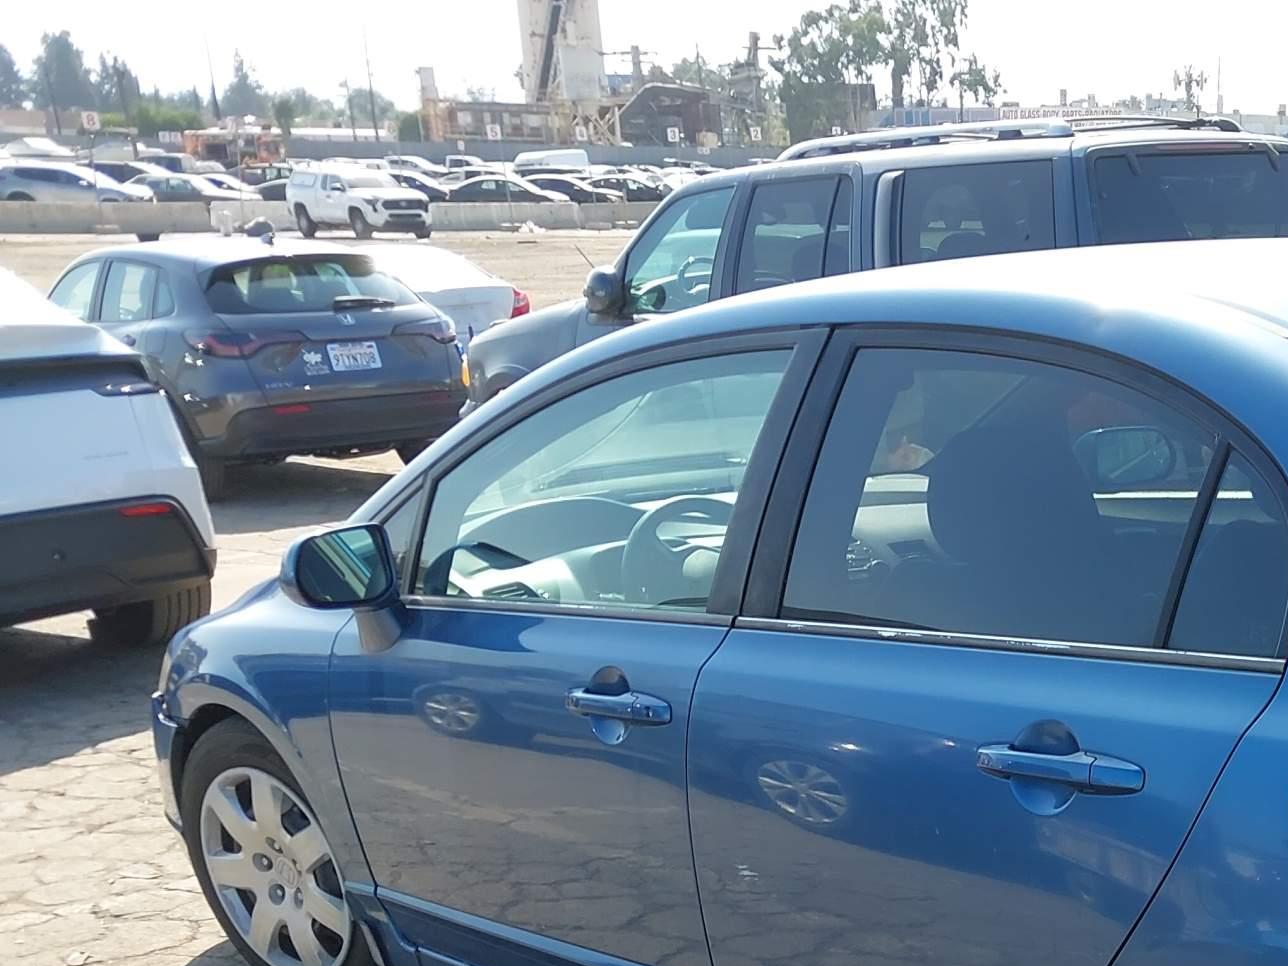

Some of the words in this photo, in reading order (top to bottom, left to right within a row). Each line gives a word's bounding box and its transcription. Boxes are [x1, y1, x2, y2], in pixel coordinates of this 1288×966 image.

[86, 113, 96, 127] 8
[1002, 110, 1018, 120] AUTO
[1020, 110, 1040, 119] GLASS
